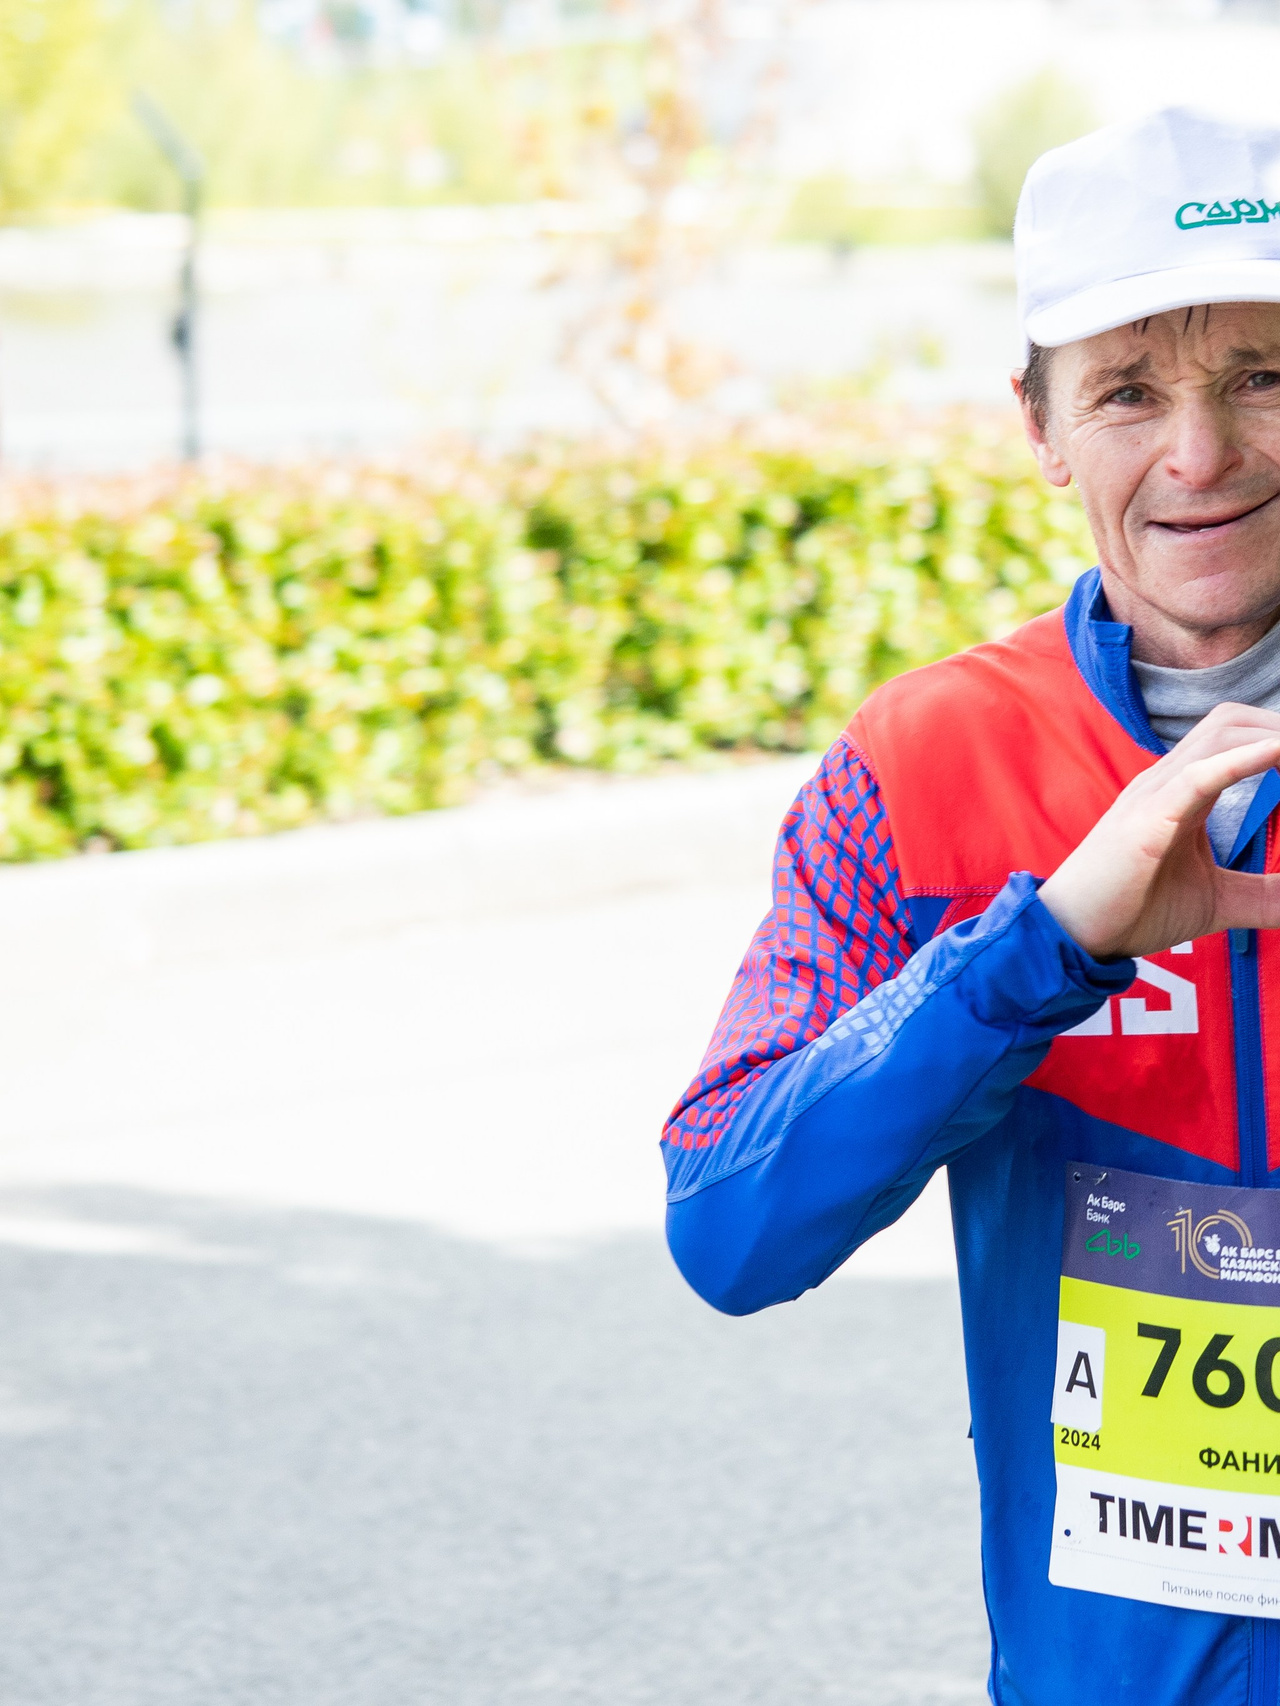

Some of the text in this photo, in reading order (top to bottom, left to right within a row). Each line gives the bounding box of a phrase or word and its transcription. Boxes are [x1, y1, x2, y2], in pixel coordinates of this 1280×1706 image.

[1086, 1193, 1126, 1214] Ак Барс
[1086, 1208, 1111, 1225] Банк
[1220, 1245, 1239, 1258] АК
[1240, 1247, 1274, 1260] БАРС
[1064, 1350, 1098, 1400] A
[1060, 1427, 1102, 1451] 2024
[1161, 1580, 1213, 1599] Питание
[1216, 1590, 1254, 1604] после
